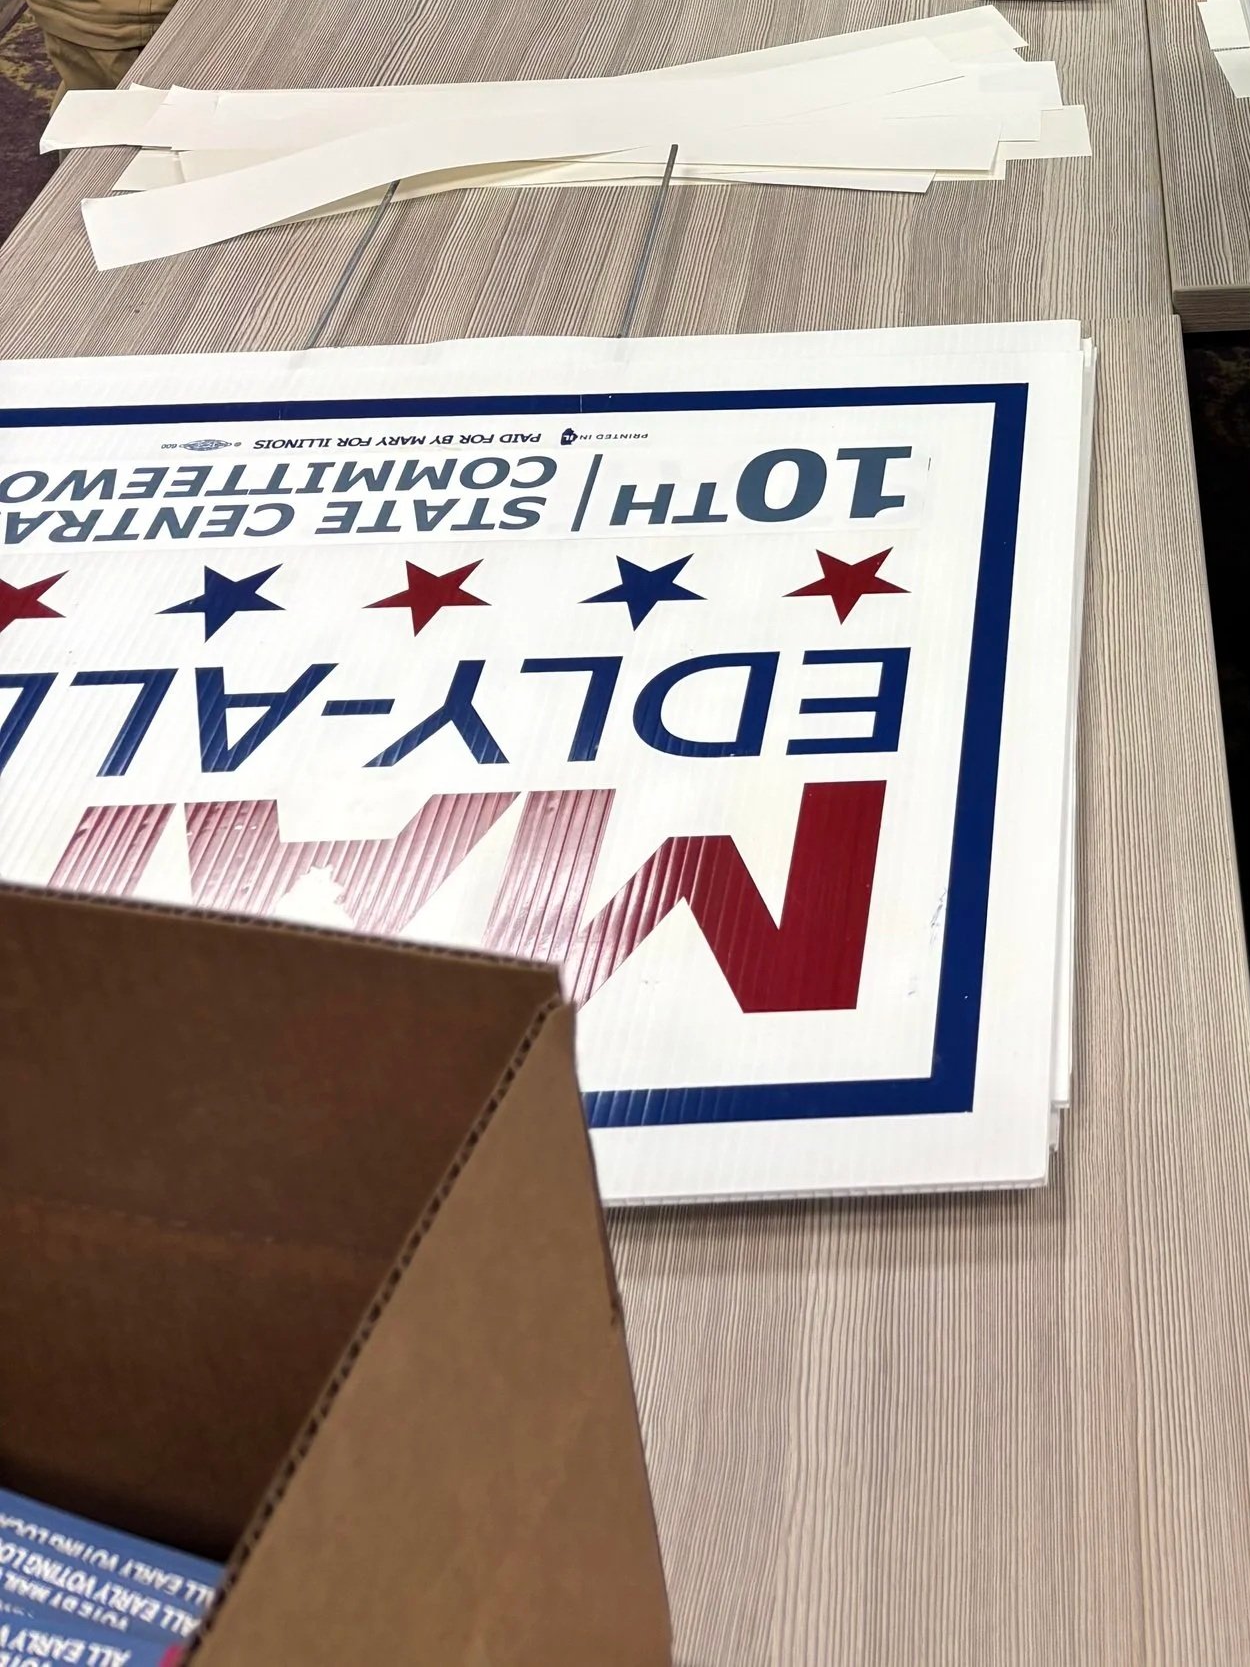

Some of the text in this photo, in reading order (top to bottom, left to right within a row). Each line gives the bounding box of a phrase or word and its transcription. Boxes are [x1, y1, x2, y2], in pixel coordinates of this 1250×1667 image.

[253, 433, 542, 450] PAID FOR BY MARY FOR ILLINOIS
[609, 445, 913, 527] 10TH
[315, 496, 548, 535] STATE
[23, 1551, 98, 1598] VOTING
[119, 1559, 184, 1596] EARLY
[94, 1581, 161, 1622] EARLY
[160, 1604, 202, 1638] ALL
[8, 1628, 86, 1664] EARLY
